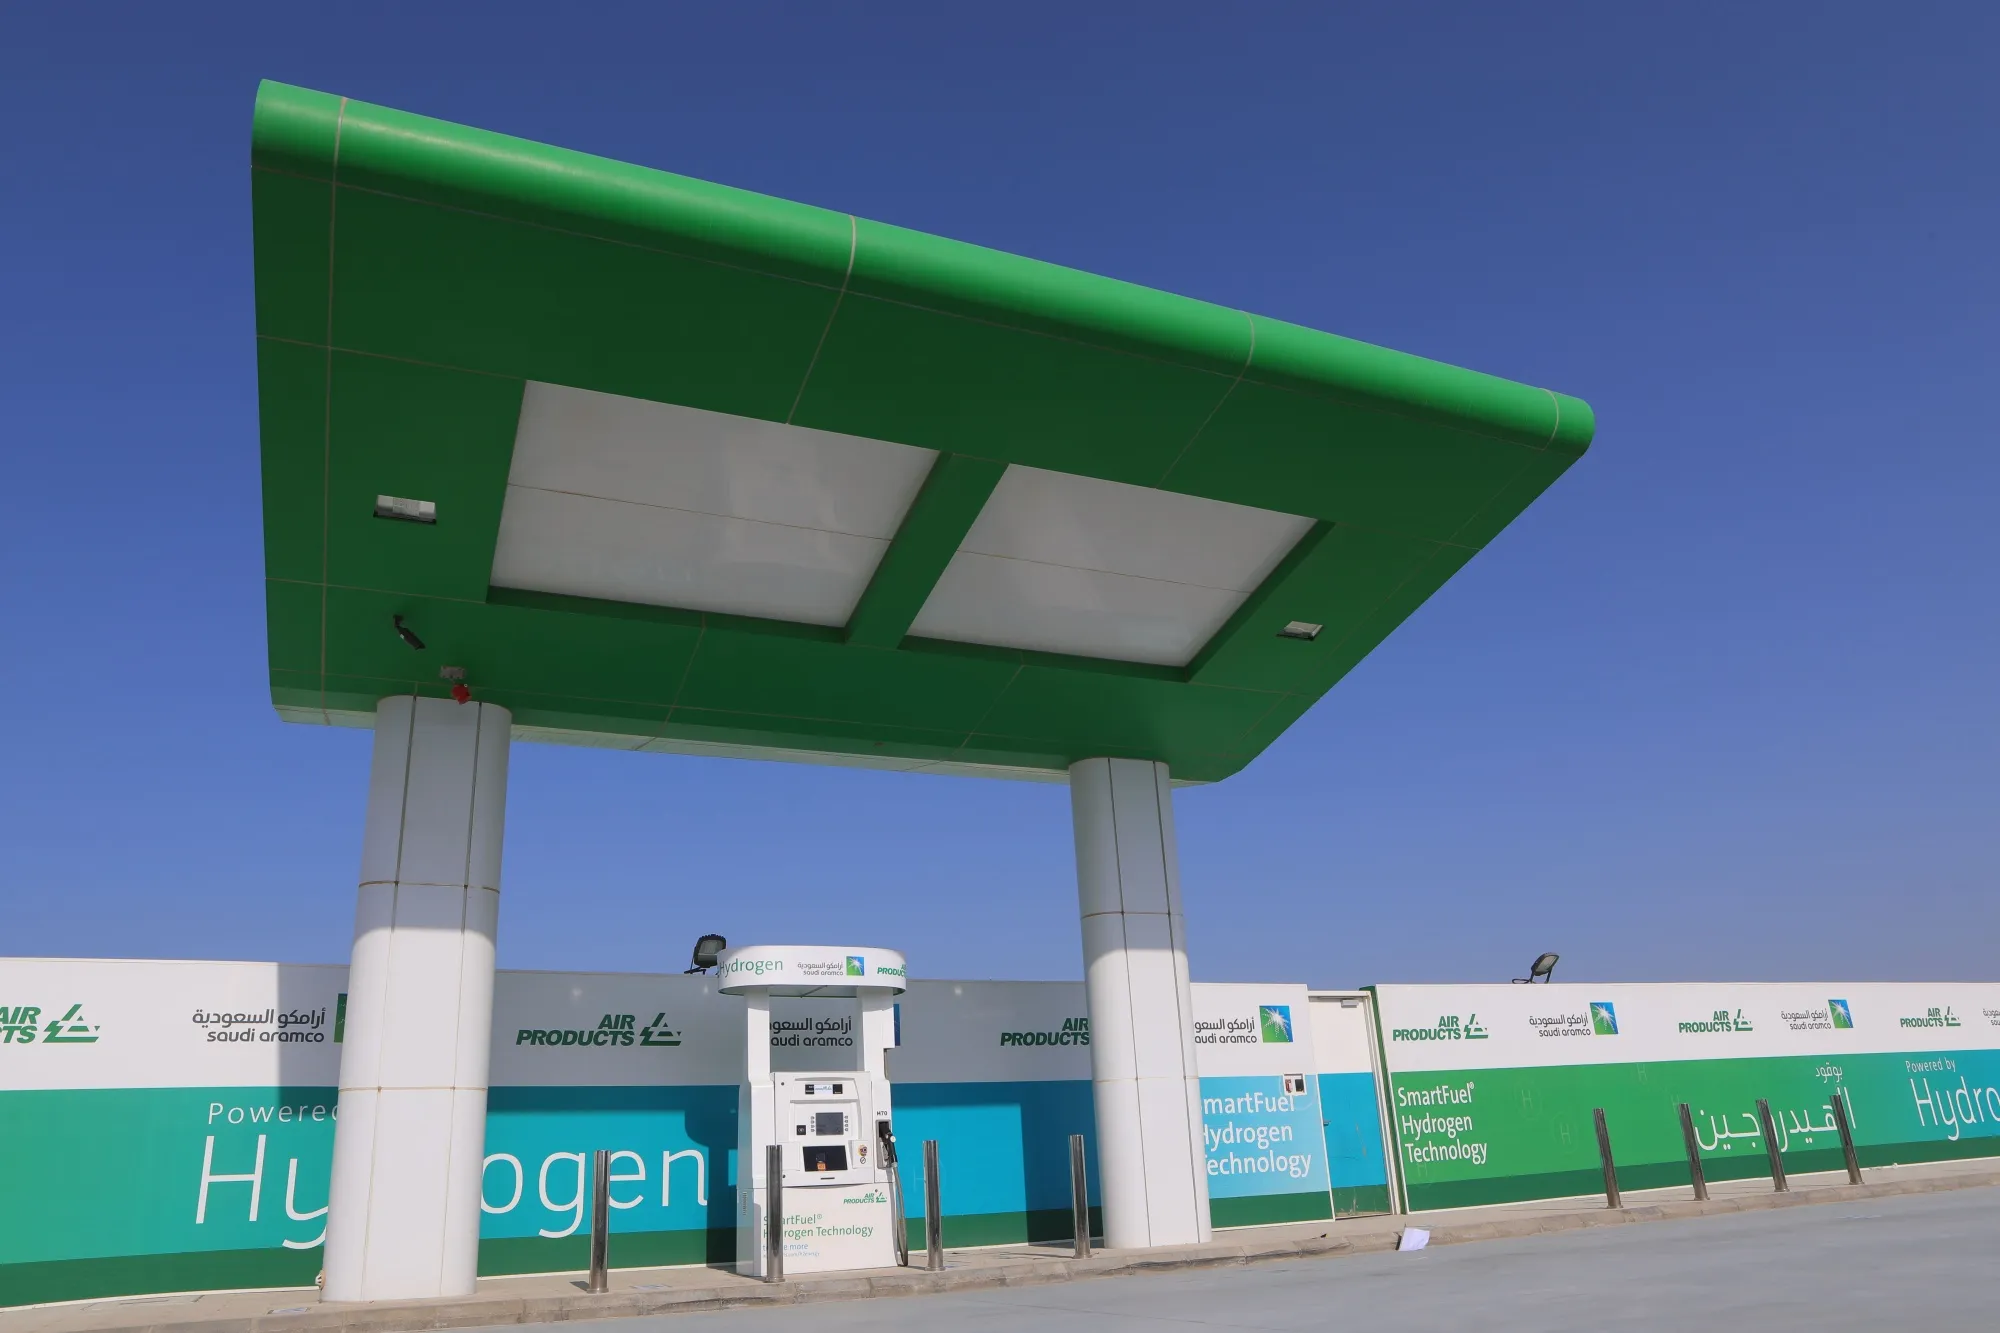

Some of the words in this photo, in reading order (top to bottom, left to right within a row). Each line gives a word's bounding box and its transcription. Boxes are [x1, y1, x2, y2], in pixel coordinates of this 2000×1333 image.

[719, 958, 783, 978] Hydrogen
[876, 967, 907, 978] PRODUC
[0, 1006, 41, 1025] AIR
[192, 1009, 275, 1029] السعودية
[277, 1007, 326, 1029] أرامكو
[1566, 1012, 1588, 1028] أرامكو
[1713, 1010, 1730, 1021] AIR
[1927, 1008, 1941, 1018] AIR
[598, 1014, 636, 1030] AIR
[769, 1017, 813, 1035] السعو
[815, 1016, 852, 1035] أرامكو
[1061, 1017, 1089, 1031] AIR
[1194, 1018, 1225, 1033] السعو
[1226, 1017, 1255, 1033] أرامكو
[1437, 1016, 1460, 1028] AIR
[1529, 1014, 1566, 1029] السعودية
[1678, 1021, 1732, 1033] PRODUCTS
[1790, 1021, 1807, 1030] saudi
[1808, 1022, 1832, 1030] aramco
[1900, 1017, 1944, 1028] PRODUCTS
[207, 1028, 255, 1042] saudi
[259, 1031, 325, 1043] aramco
[515, 1030, 636, 1047] PRODUCTS
[1000, 1032, 1090, 1046] PRODUCTS
[1194, 1034, 1217, 1044] audi
[1219, 1035, 1257, 1044] aramco
[1392, 1028, 1462, 1042] PRODUCTS
[1538, 1027, 1560, 1037] saudi
[1561, 1028, 1591, 1037] aramco
[770, 1034, 800, 1047] audi
[803, 1037, 853, 1047] aramco
[1905, 1058, 1943, 1073] Powered
[1944, 1057, 1957, 1073] by
[1200, 1091, 1295, 1115] martFuel
[1909, 1075, 2000, 1141] Hydro
[1401, 1112, 1473, 1141] Hydrogen
[1404, 1138, 1488, 1165] Technology
[1205, 1150, 1312, 1179] echnology
[195, 1134, 708, 1250] Hyogen
[763, 1227, 814, 1240] Hrogen
[815, 1225, 874, 1238] Technology
[789, 1243, 809, 1251] more
